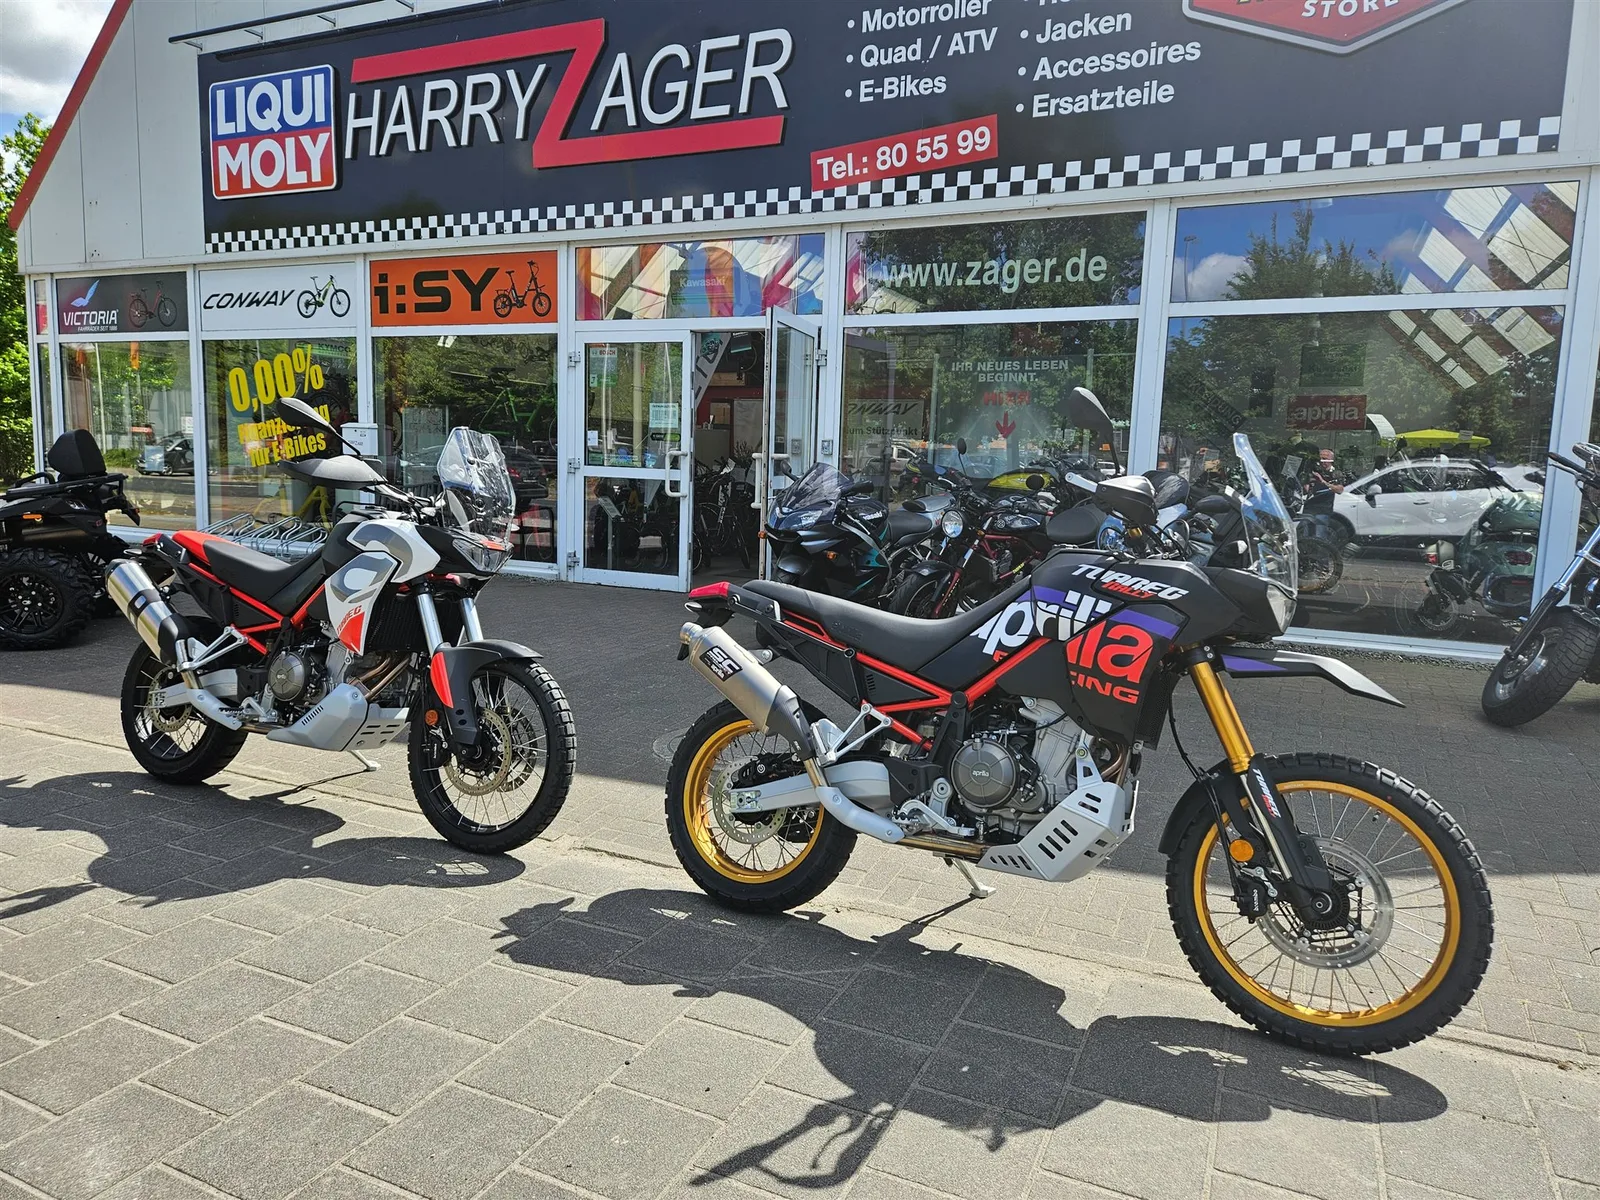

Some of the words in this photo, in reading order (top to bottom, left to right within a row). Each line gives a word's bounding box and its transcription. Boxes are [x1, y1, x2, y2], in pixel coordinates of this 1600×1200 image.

[861, 0, 992, 33] Motorroller
[1036, 12, 1132, 43] Jacken
[860, 38, 922, 67] Quad
[947, 27, 998, 57] ATV
[1033, 41, 1201, 81] Accessoires
[216, 74, 325, 136] LIQUI
[859, 74, 947, 102] E-Bikes
[1032, 80, 1175, 118] Ersatzteile
[345, 63, 546, 160] HARRY
[218, 131, 333, 191] MOLY
[817, 152, 868, 182] Tel.:
[876, 143, 908, 171] 80
[916, 134, 948, 163] 55
[957, 126, 991, 155] 99
[679, 276, 726, 287] Kawasaki
[881, 248, 1108, 294] www.zager.de
[203, 289, 296, 309] CONWAY
[63, 310, 117, 326] VICTORIA
[228, 344, 324, 413] 0,00%
[951, 362, 973, 372] IHR
[977, 361, 1020, 372] NEUES
[1024, 360, 1069, 371] LEBEN
[1295, 402, 1360, 423] aprilia
[272, 432, 327, 462] E-Bikes
[1071, 563, 1189, 600] TUAREG
